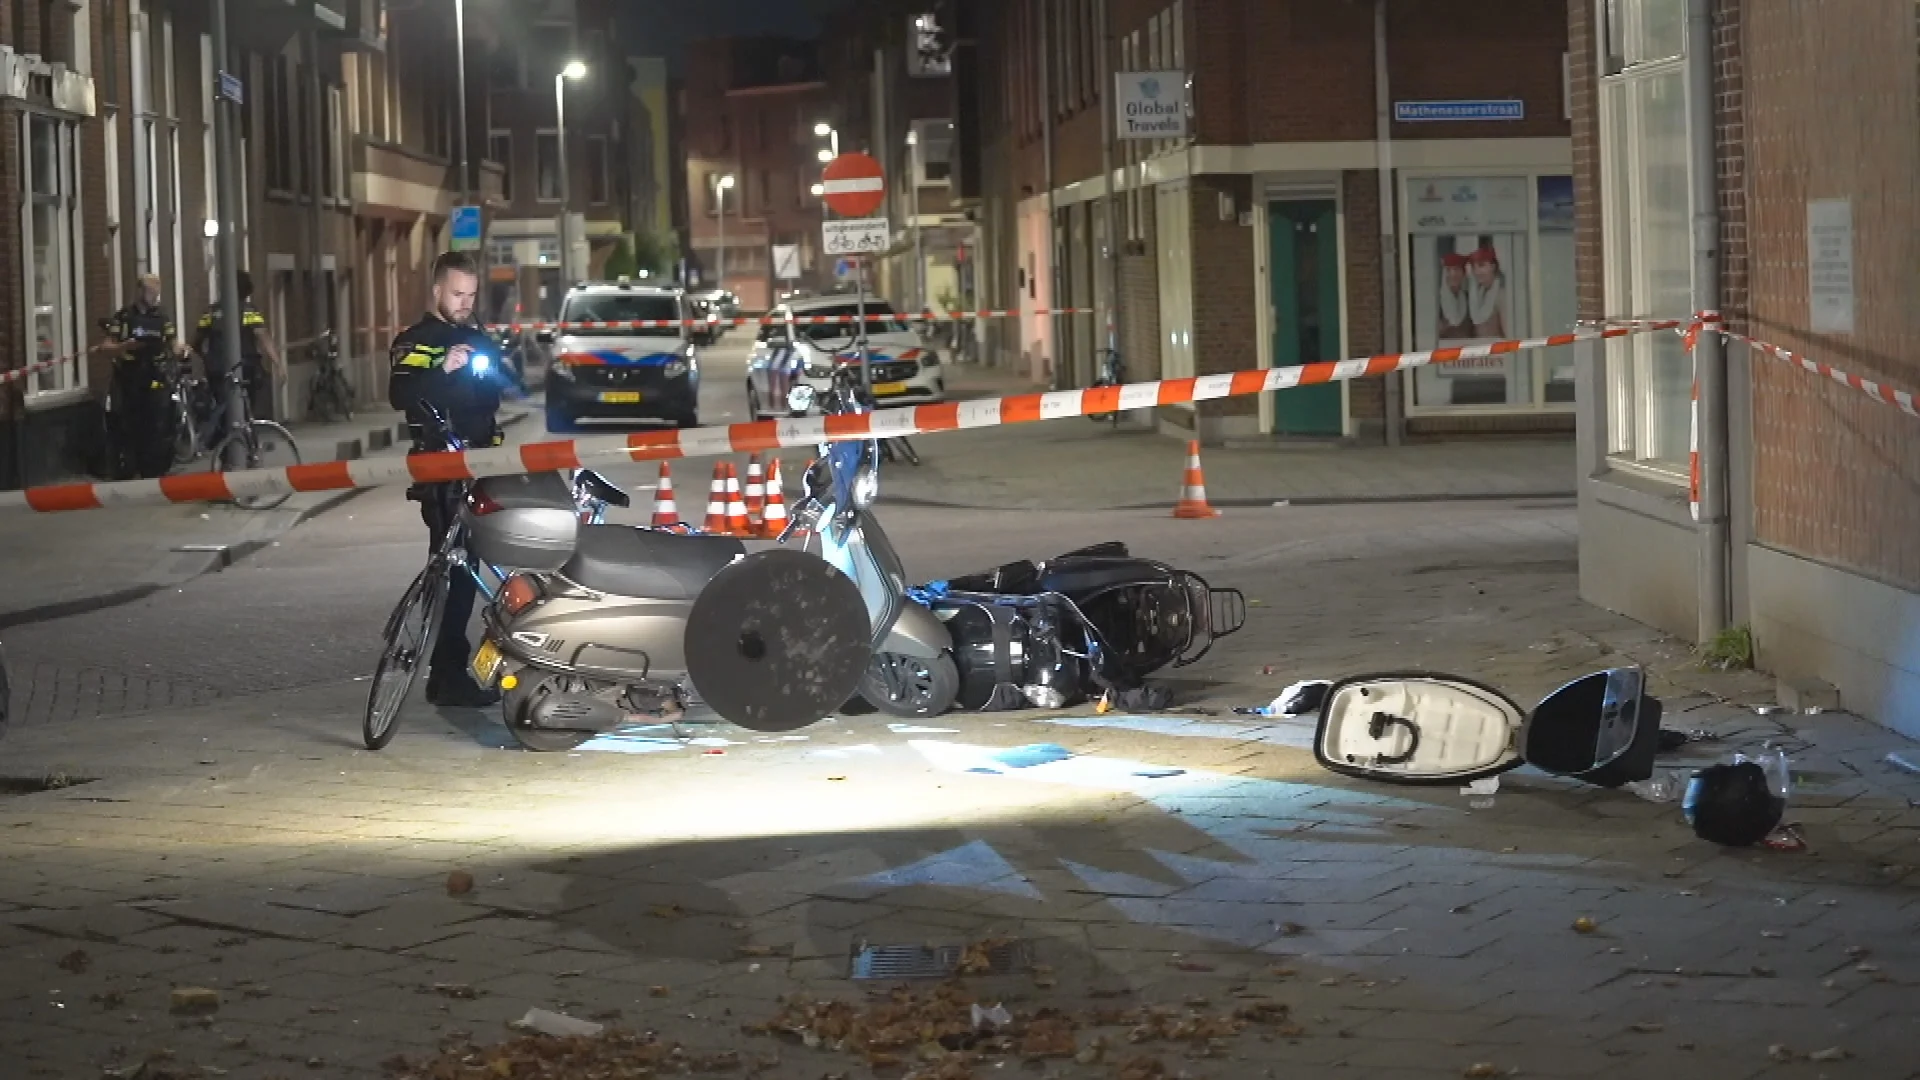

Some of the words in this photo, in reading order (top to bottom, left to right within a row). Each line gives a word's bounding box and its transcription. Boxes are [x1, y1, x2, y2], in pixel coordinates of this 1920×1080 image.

[1126, 102, 1179, 116] Global
[1399, 104, 1519, 117] Mathenesserstraat
[1126, 118, 1180, 131] Travels
